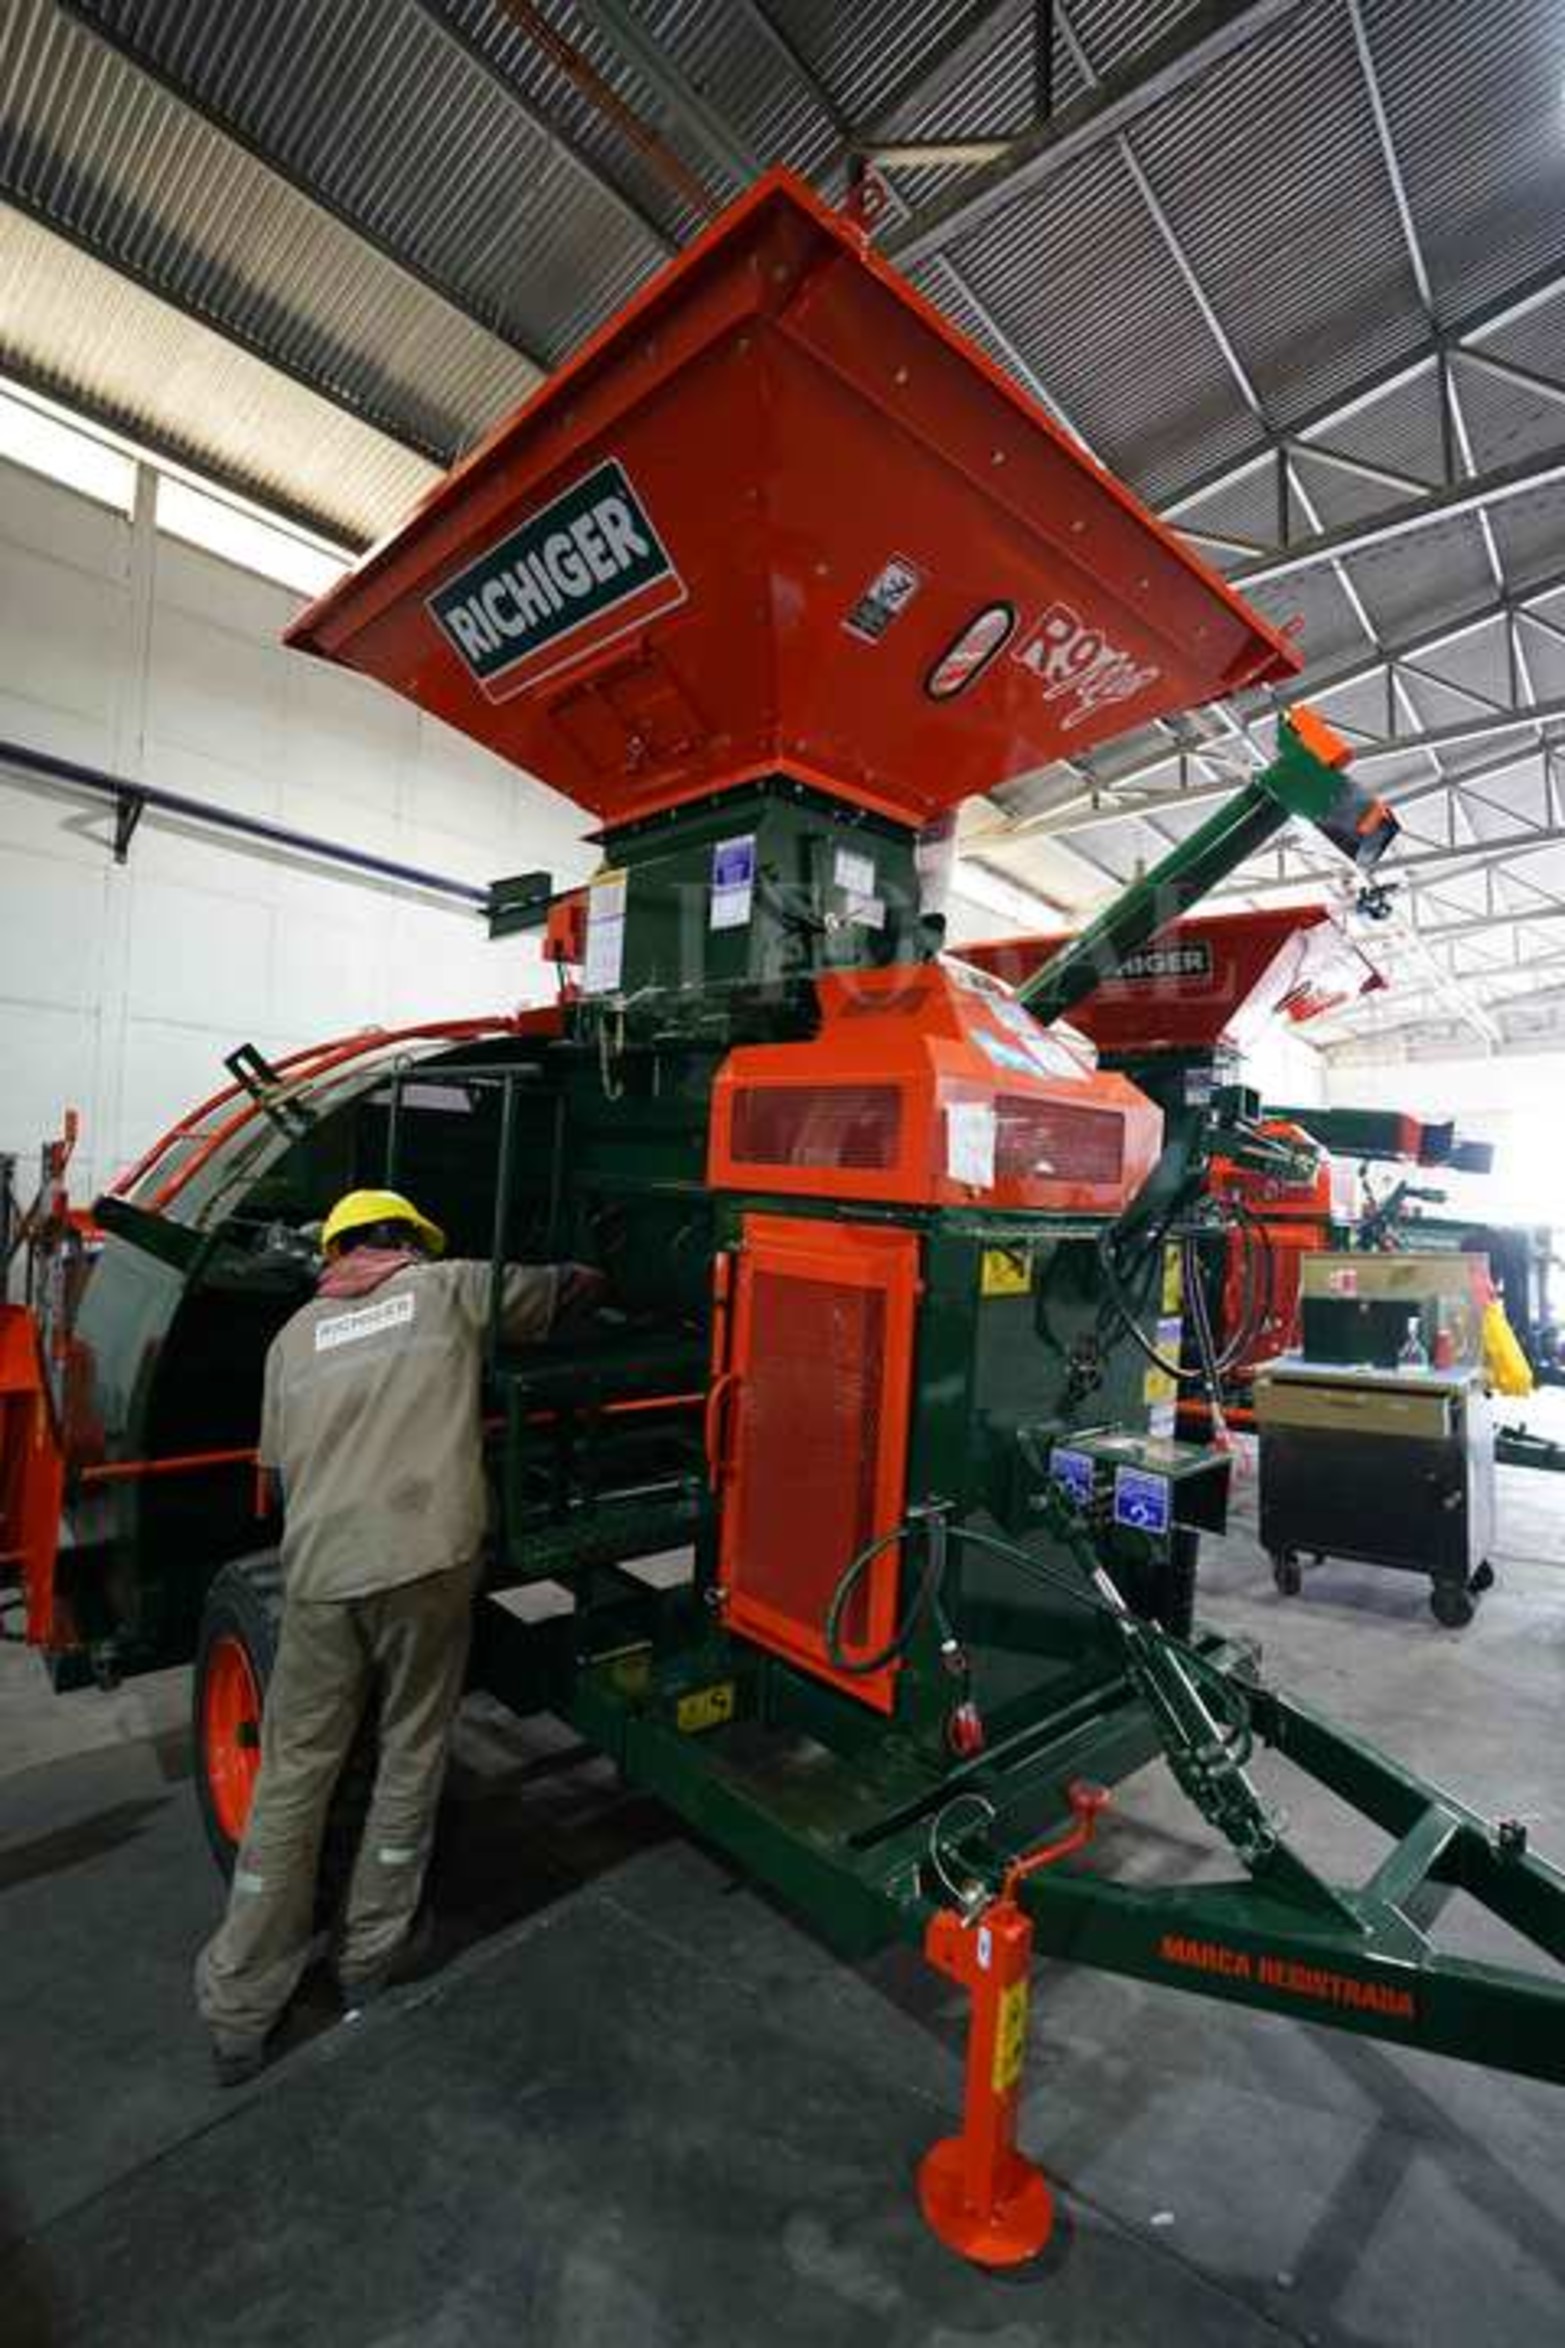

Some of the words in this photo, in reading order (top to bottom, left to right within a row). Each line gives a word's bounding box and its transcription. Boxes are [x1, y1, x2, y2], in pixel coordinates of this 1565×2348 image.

[444, 496, 650, 662] RICHIGER
[1114, 950, 1205, 977] HIGER
[1159, 1933, 1250, 1976] MARCA
